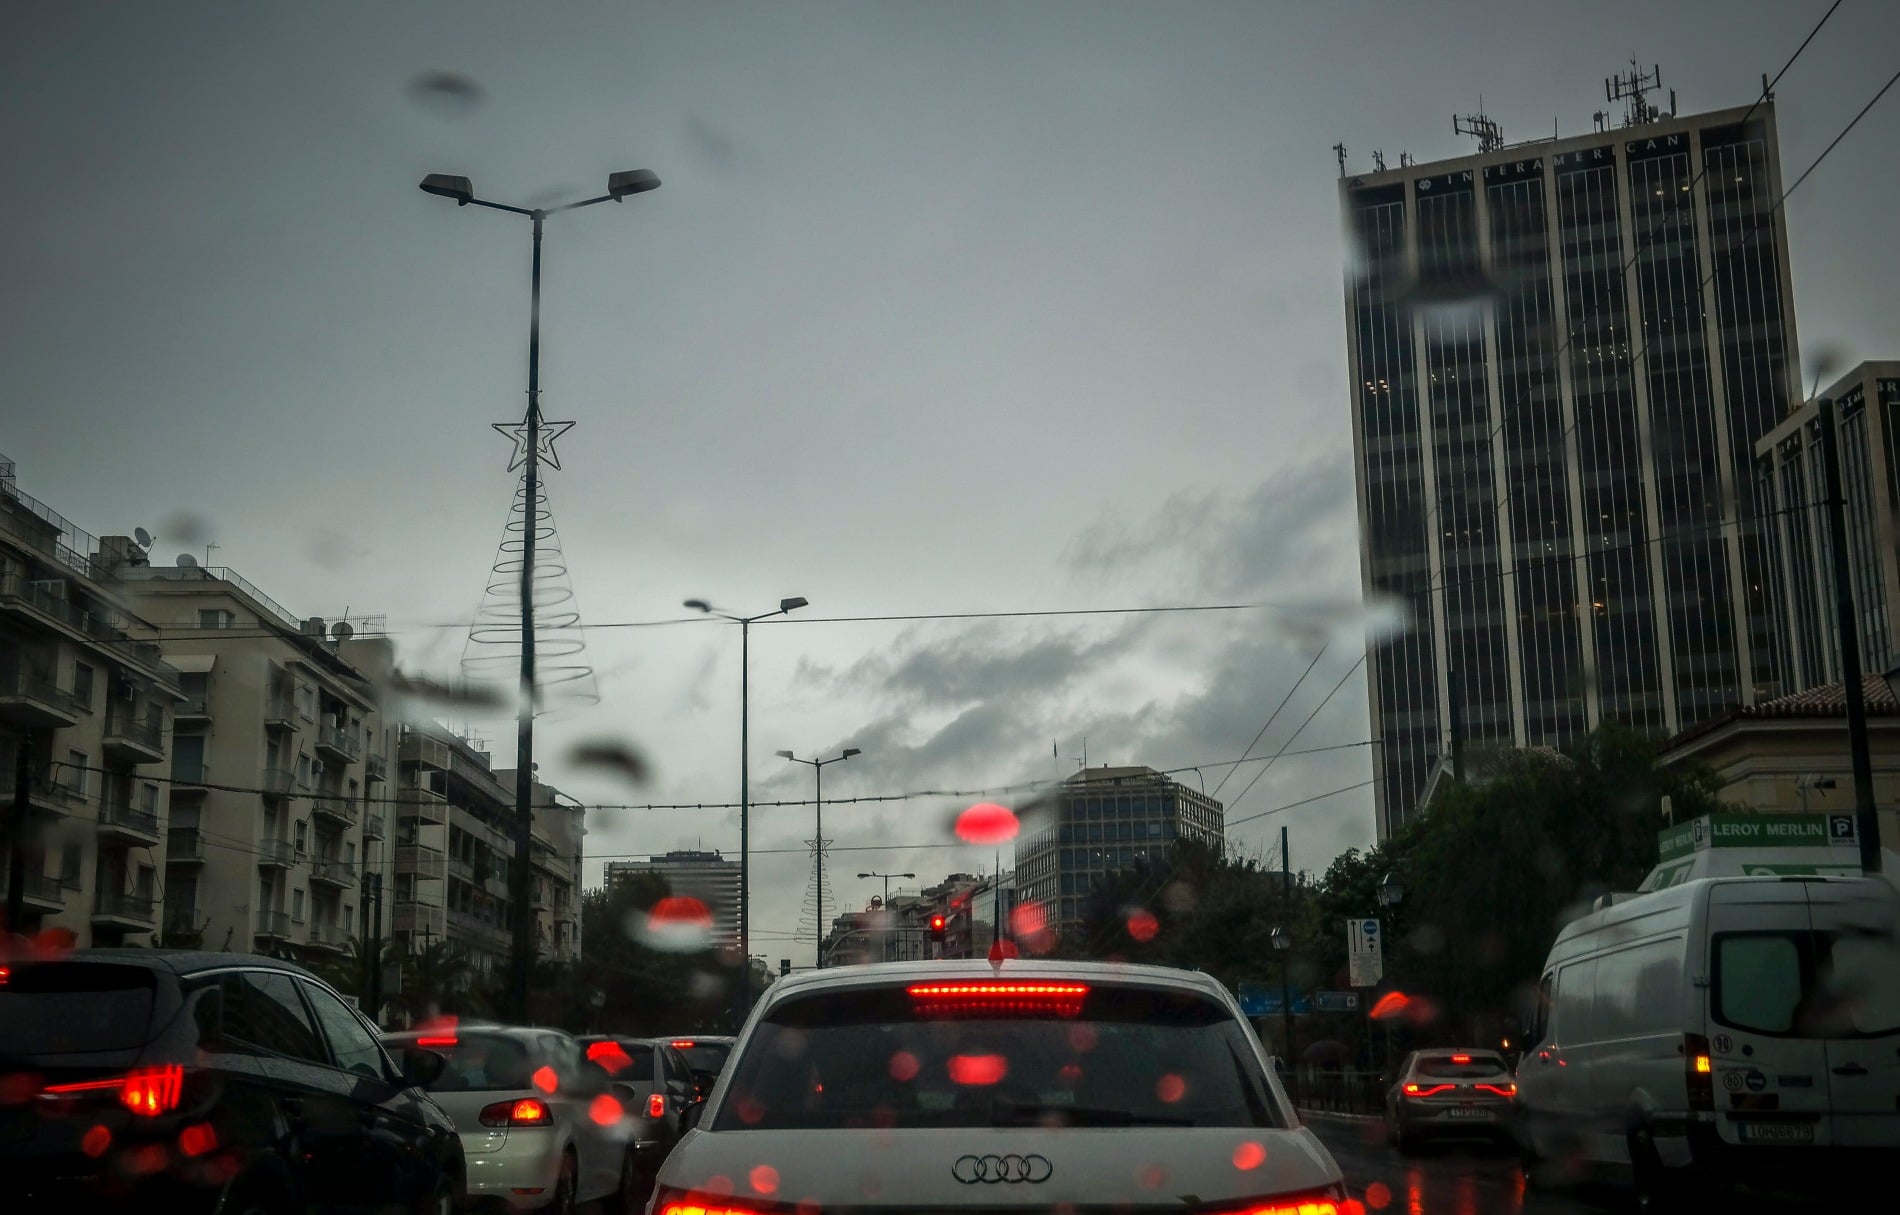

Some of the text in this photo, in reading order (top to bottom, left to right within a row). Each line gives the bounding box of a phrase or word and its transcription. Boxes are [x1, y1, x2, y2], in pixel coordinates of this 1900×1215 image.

[1447, 135, 1679, 185] INTERAMERICAN
[1713, 823, 1760, 837] LEROY
[1766, 823, 1823, 836] MERLIN
[1717, 1039, 1729, 1051] 90
